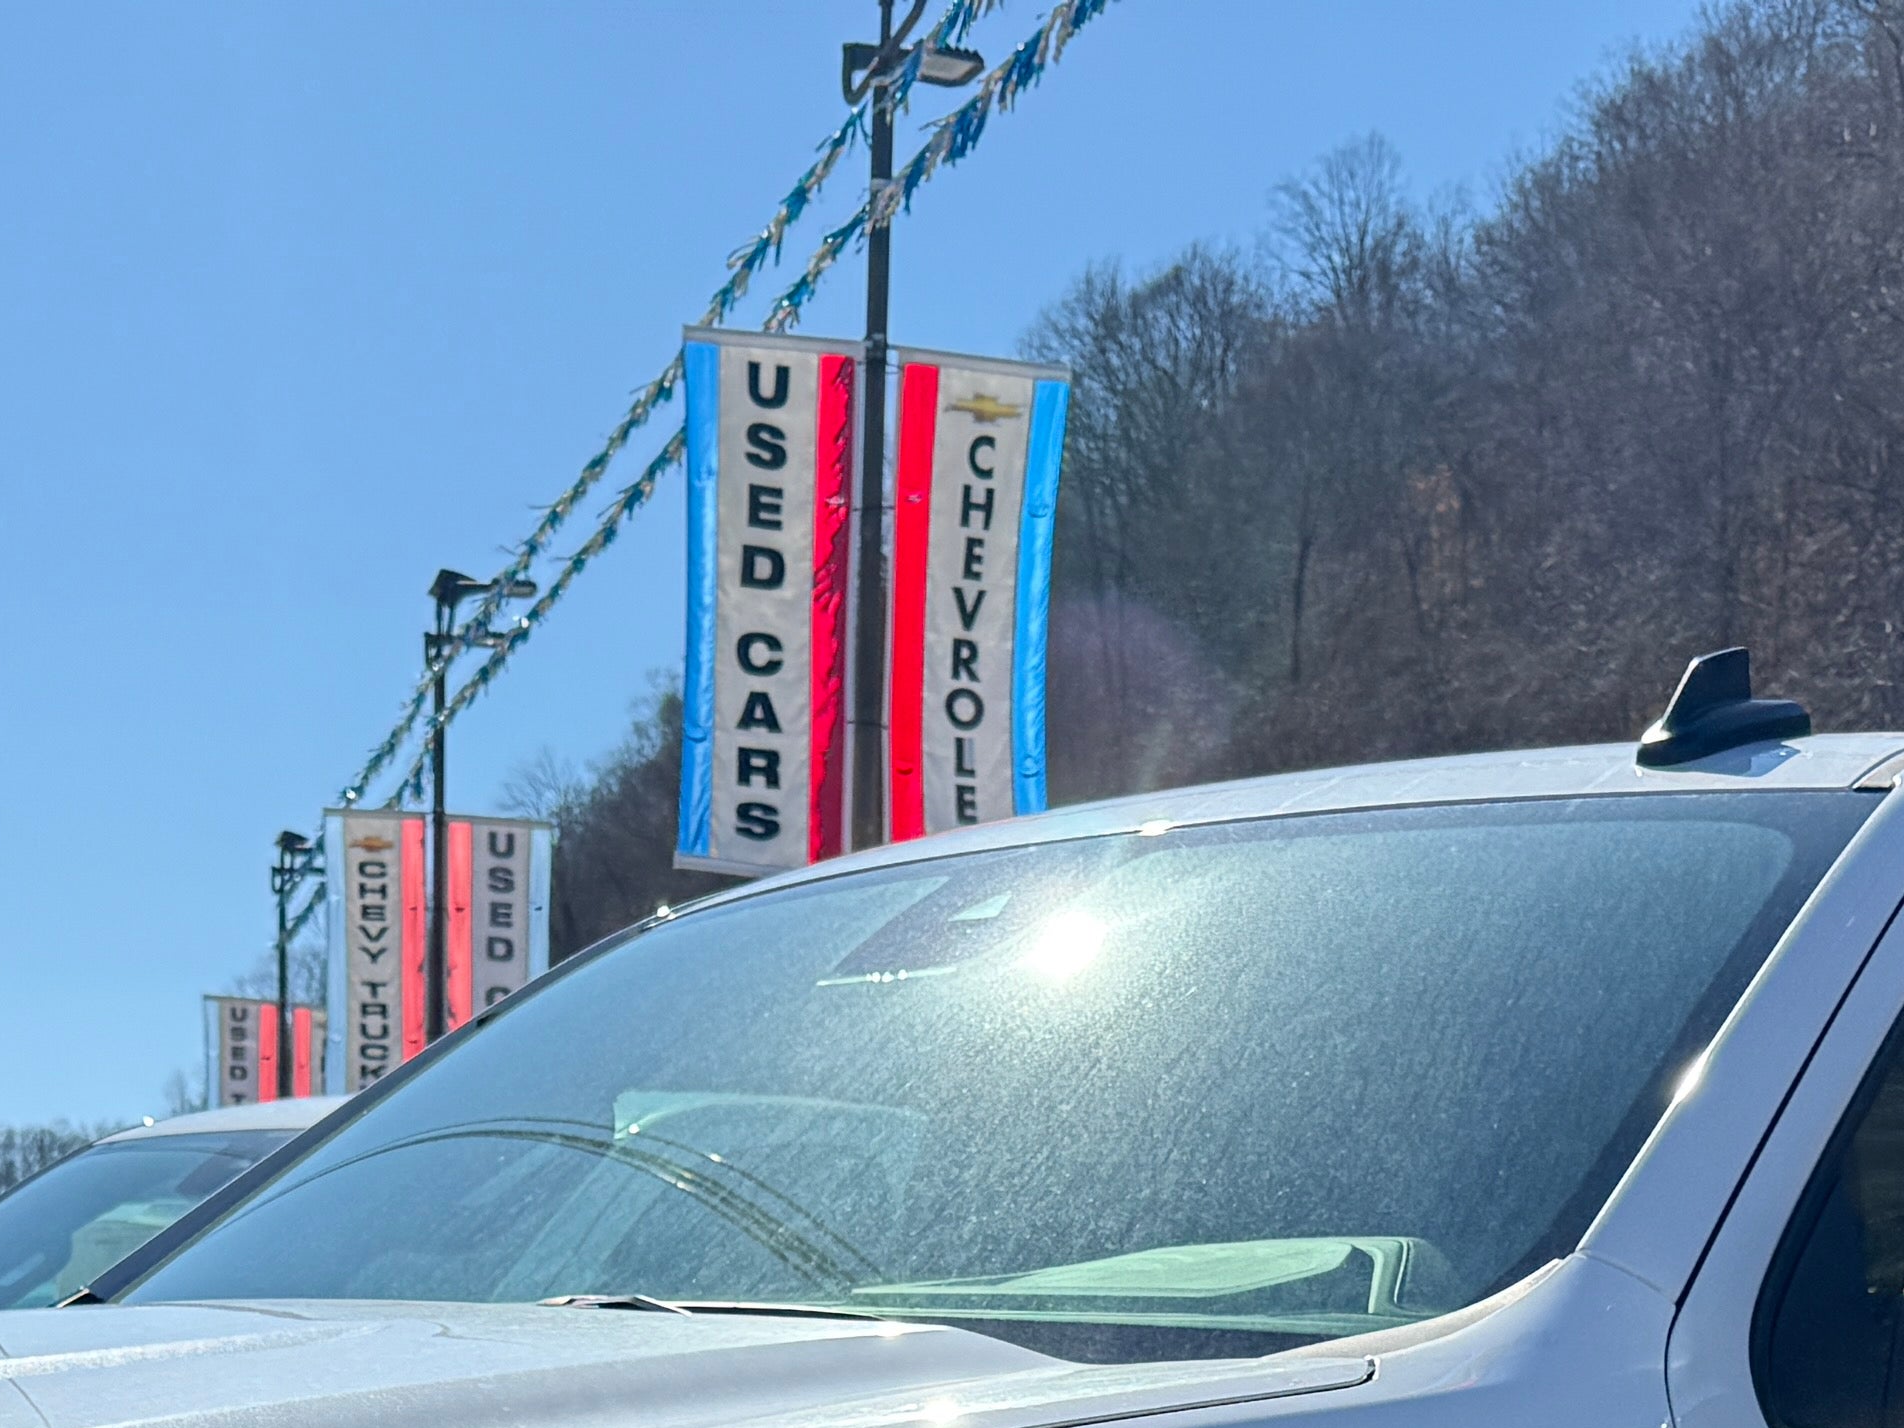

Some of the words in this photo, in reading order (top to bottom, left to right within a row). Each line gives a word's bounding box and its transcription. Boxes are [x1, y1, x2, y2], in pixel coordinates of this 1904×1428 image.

[739, 360, 791, 589] USED
[735, 632, 784, 842] CARS
[358, 861, 389, 964] CHEVY
[486, 830, 516, 963] USED
[229, 1006, 248, 1081] USED
[359, 980, 390, 1090] TRUCK
